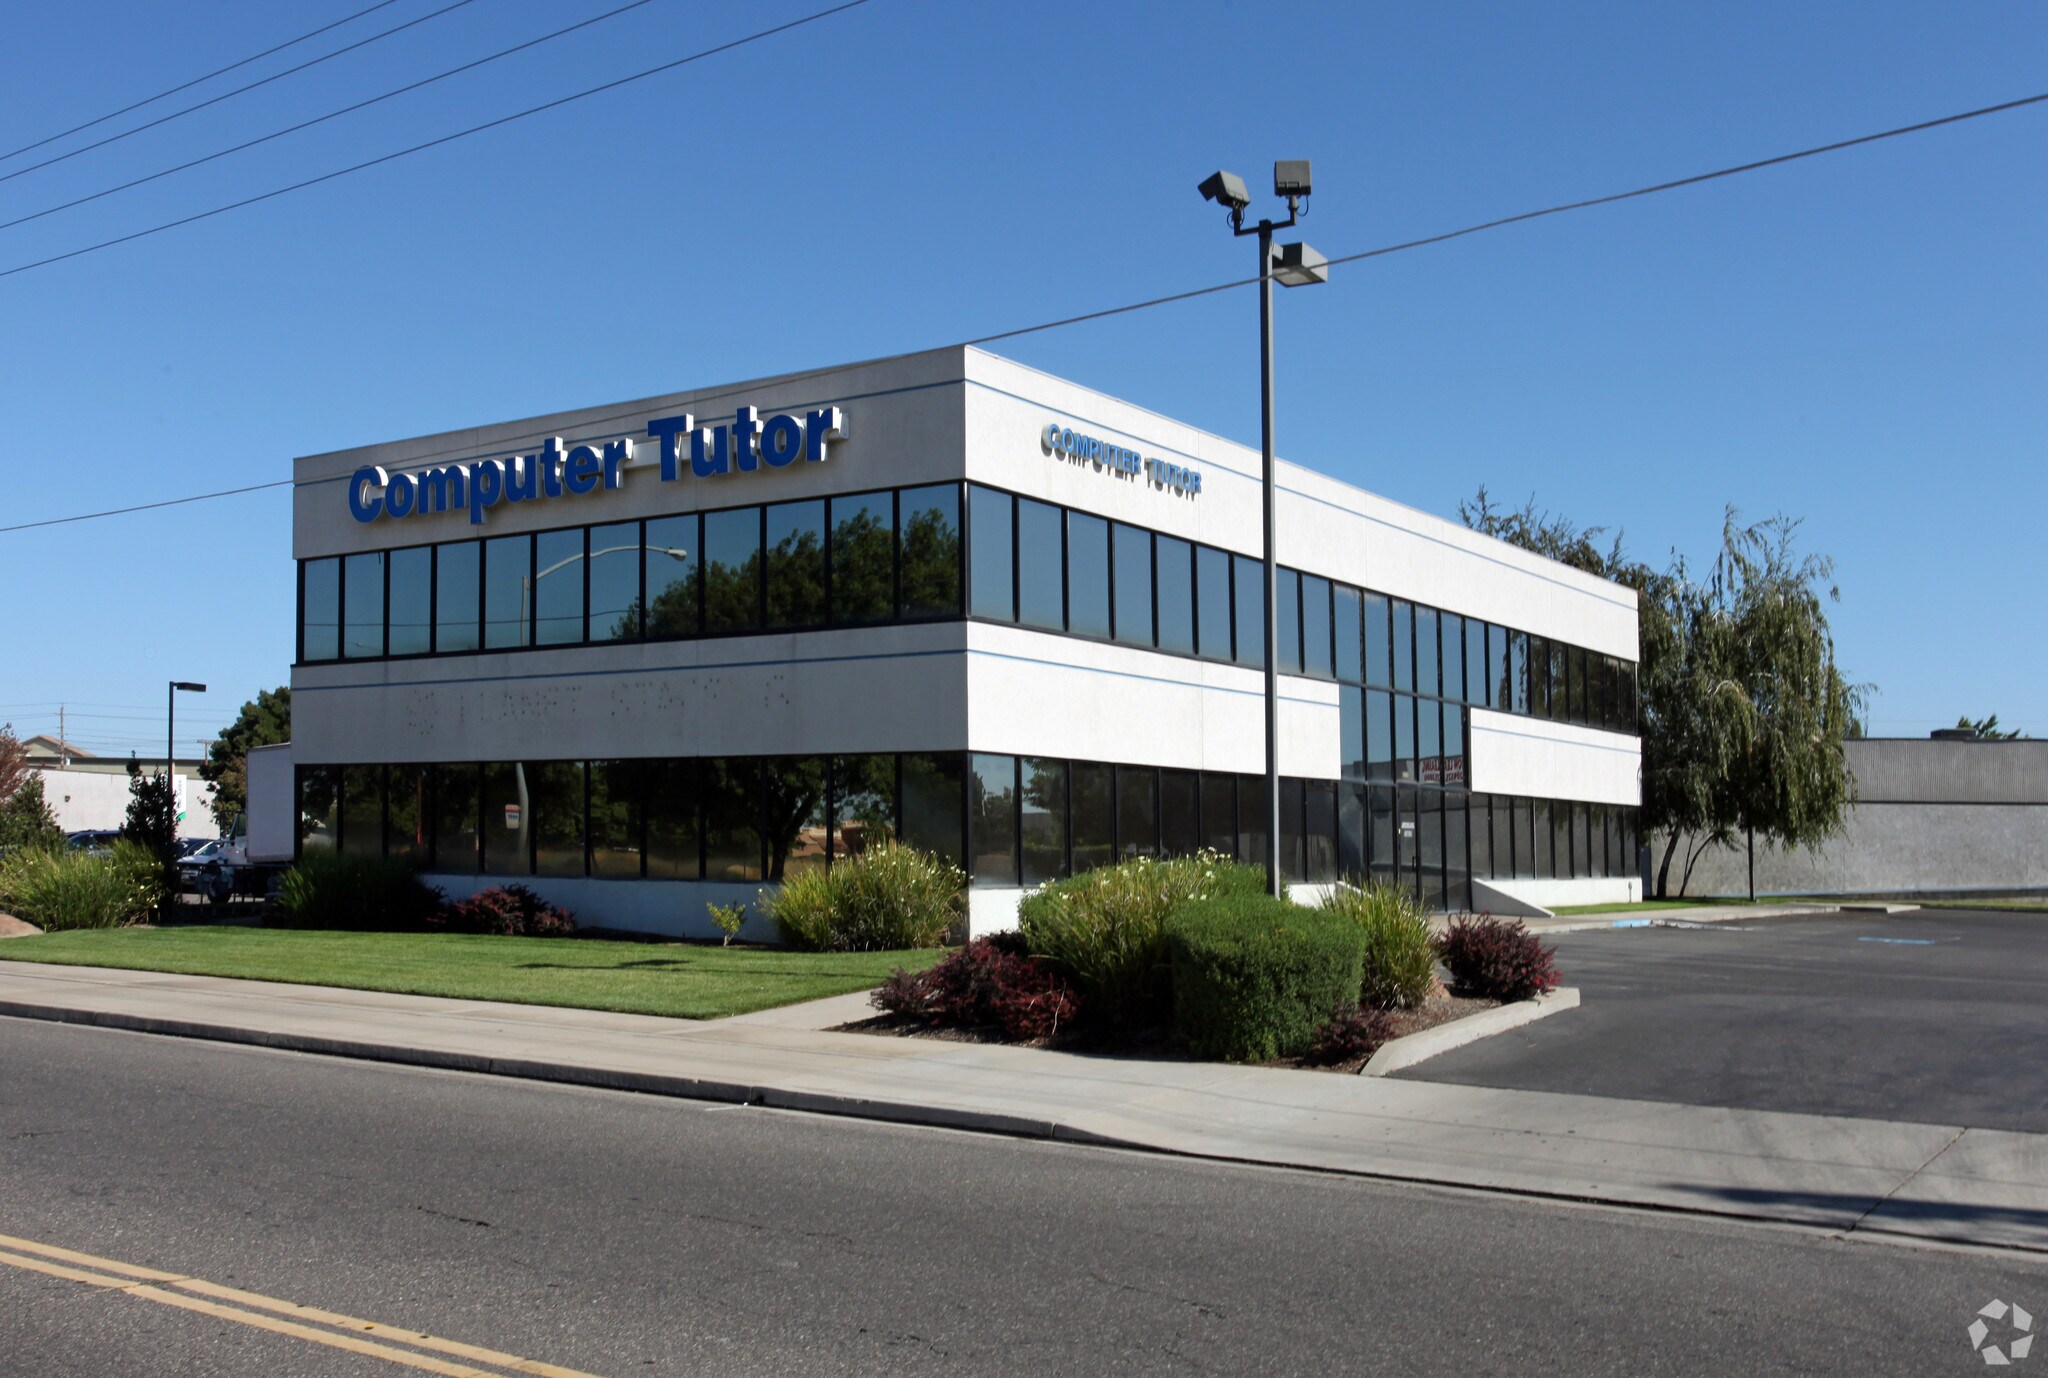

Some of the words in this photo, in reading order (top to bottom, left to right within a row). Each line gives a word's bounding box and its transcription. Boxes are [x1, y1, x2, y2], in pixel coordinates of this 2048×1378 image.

[349, 435, 631, 525] Computer
[647, 405, 842, 483] Tutor
[1045, 423, 1142, 476] COMPUTER
[1149, 457, 1202, 494] TUTOR
